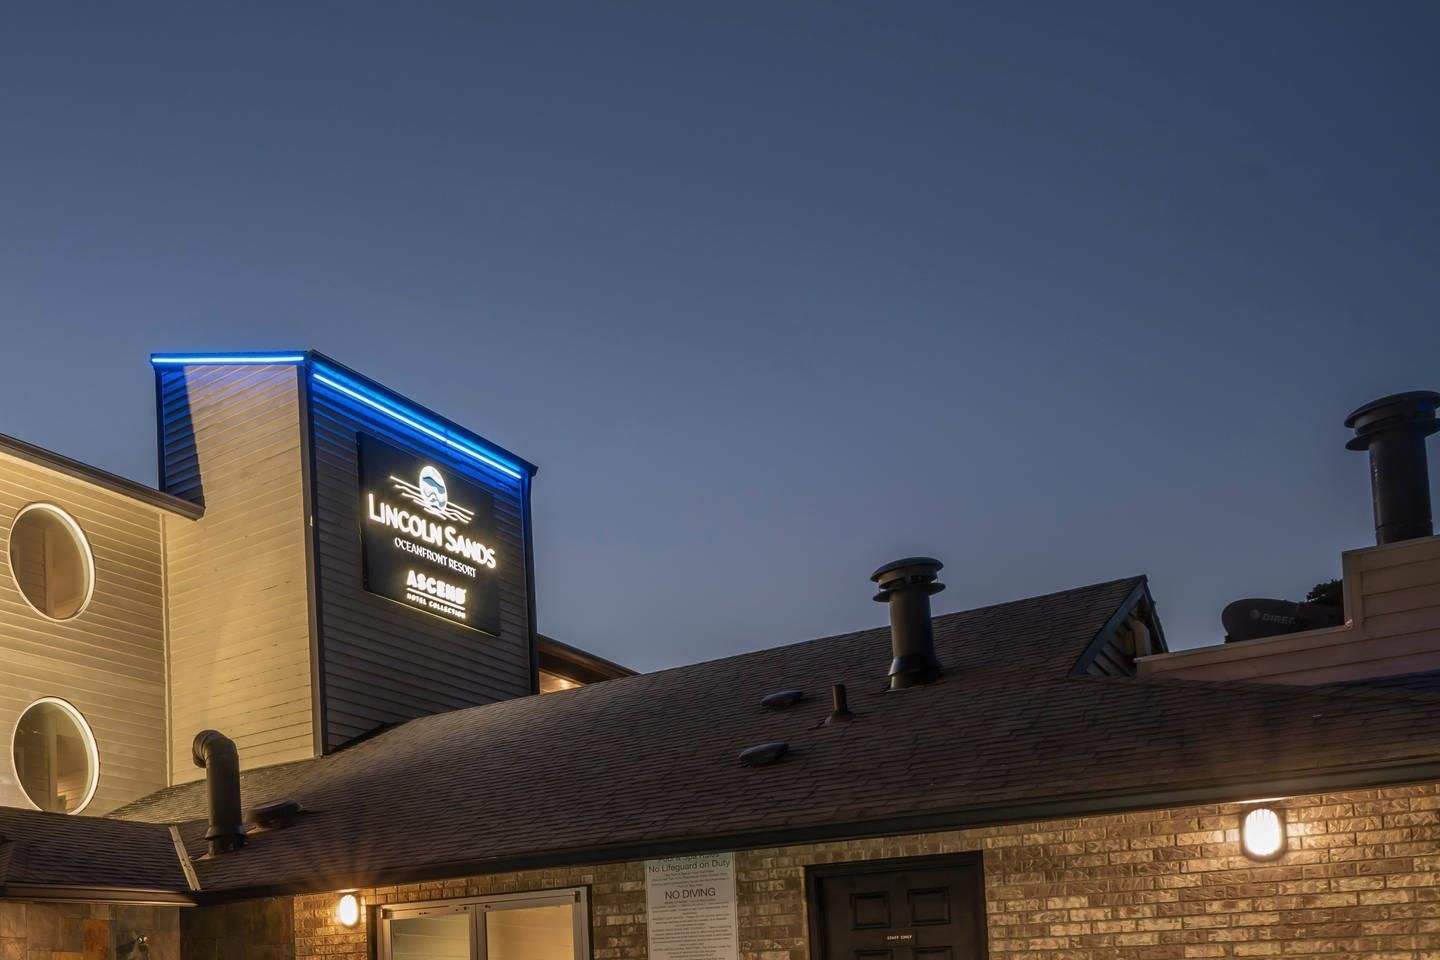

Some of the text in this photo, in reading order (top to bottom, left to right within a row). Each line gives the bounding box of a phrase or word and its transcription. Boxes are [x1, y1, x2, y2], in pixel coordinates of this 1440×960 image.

[368, 493, 497, 569] LINCOLN SANDS
[394, 537, 477, 578] OCEANFRONT RESORT
[406, 592, 466, 619] HOTEL COLLECTION
[648, 864, 660, 873] No
[661, 862, 698, 872] Lifeguard
[711, 859, 731, 868] Duty
[664, 887, 716, 900] NO DIVING
